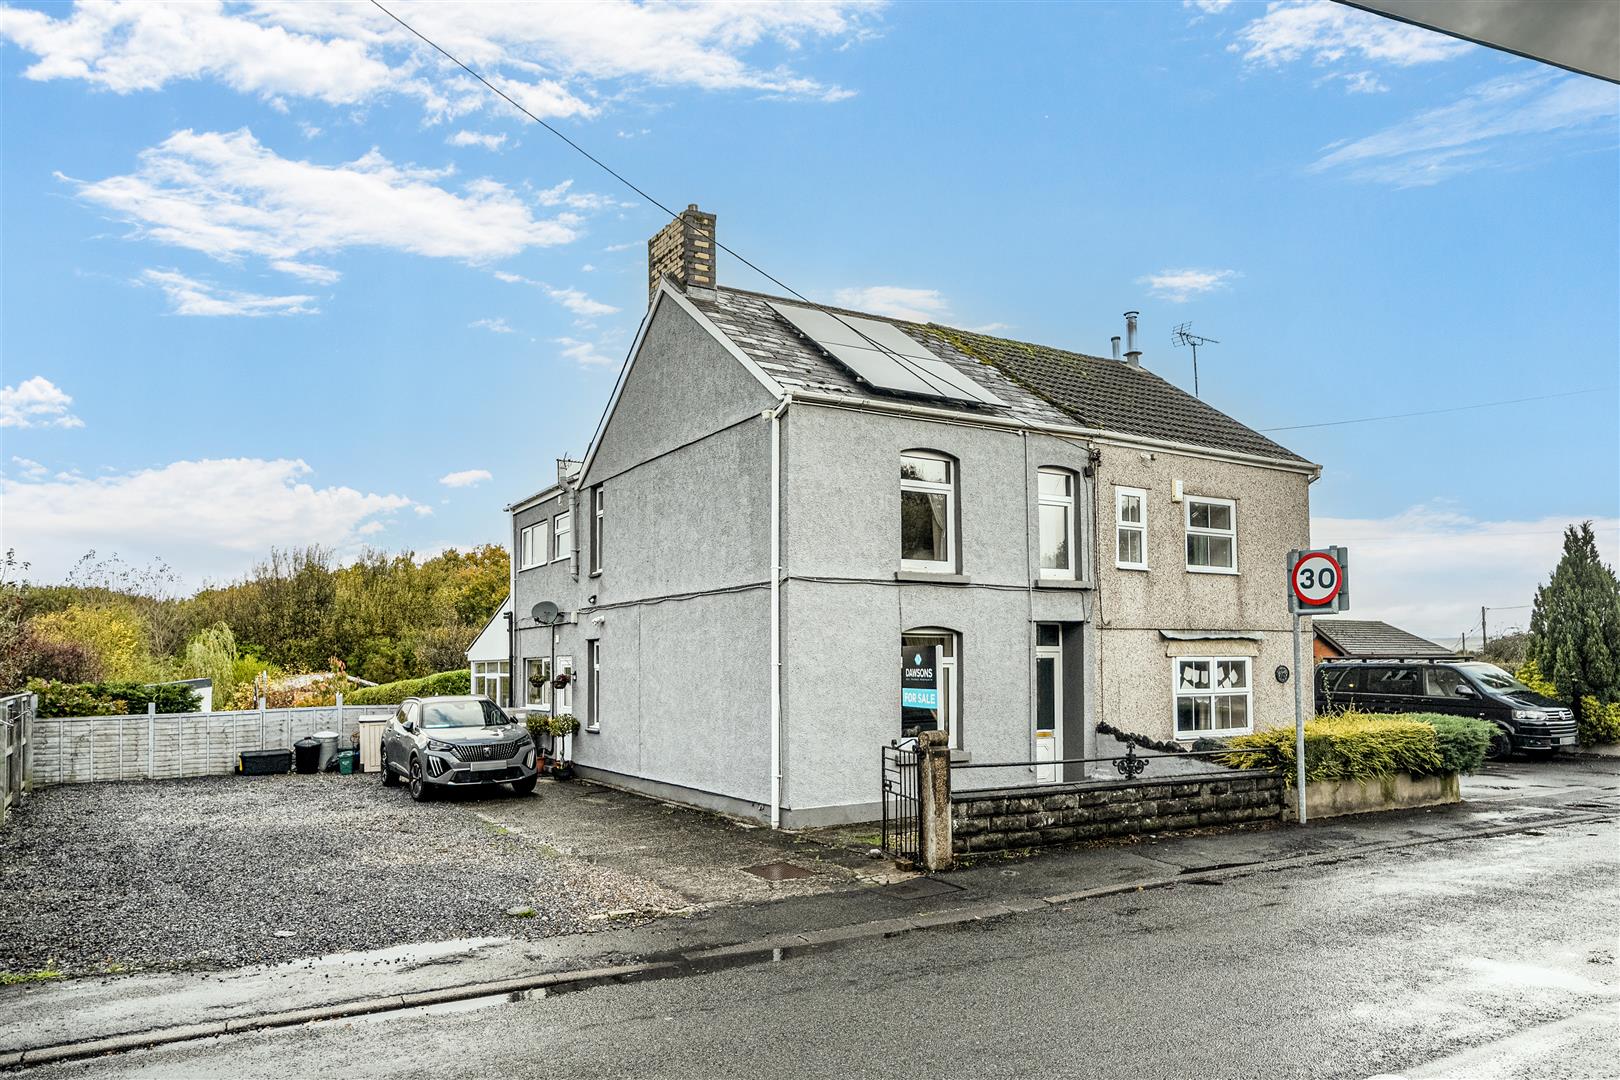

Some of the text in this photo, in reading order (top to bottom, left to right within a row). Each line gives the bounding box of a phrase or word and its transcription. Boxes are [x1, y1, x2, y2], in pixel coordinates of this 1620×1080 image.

[1300, 568, 1335, 589] 30
[905, 668, 933, 678] DAWSONS
[904, 692, 936, 705] FOR SALE
